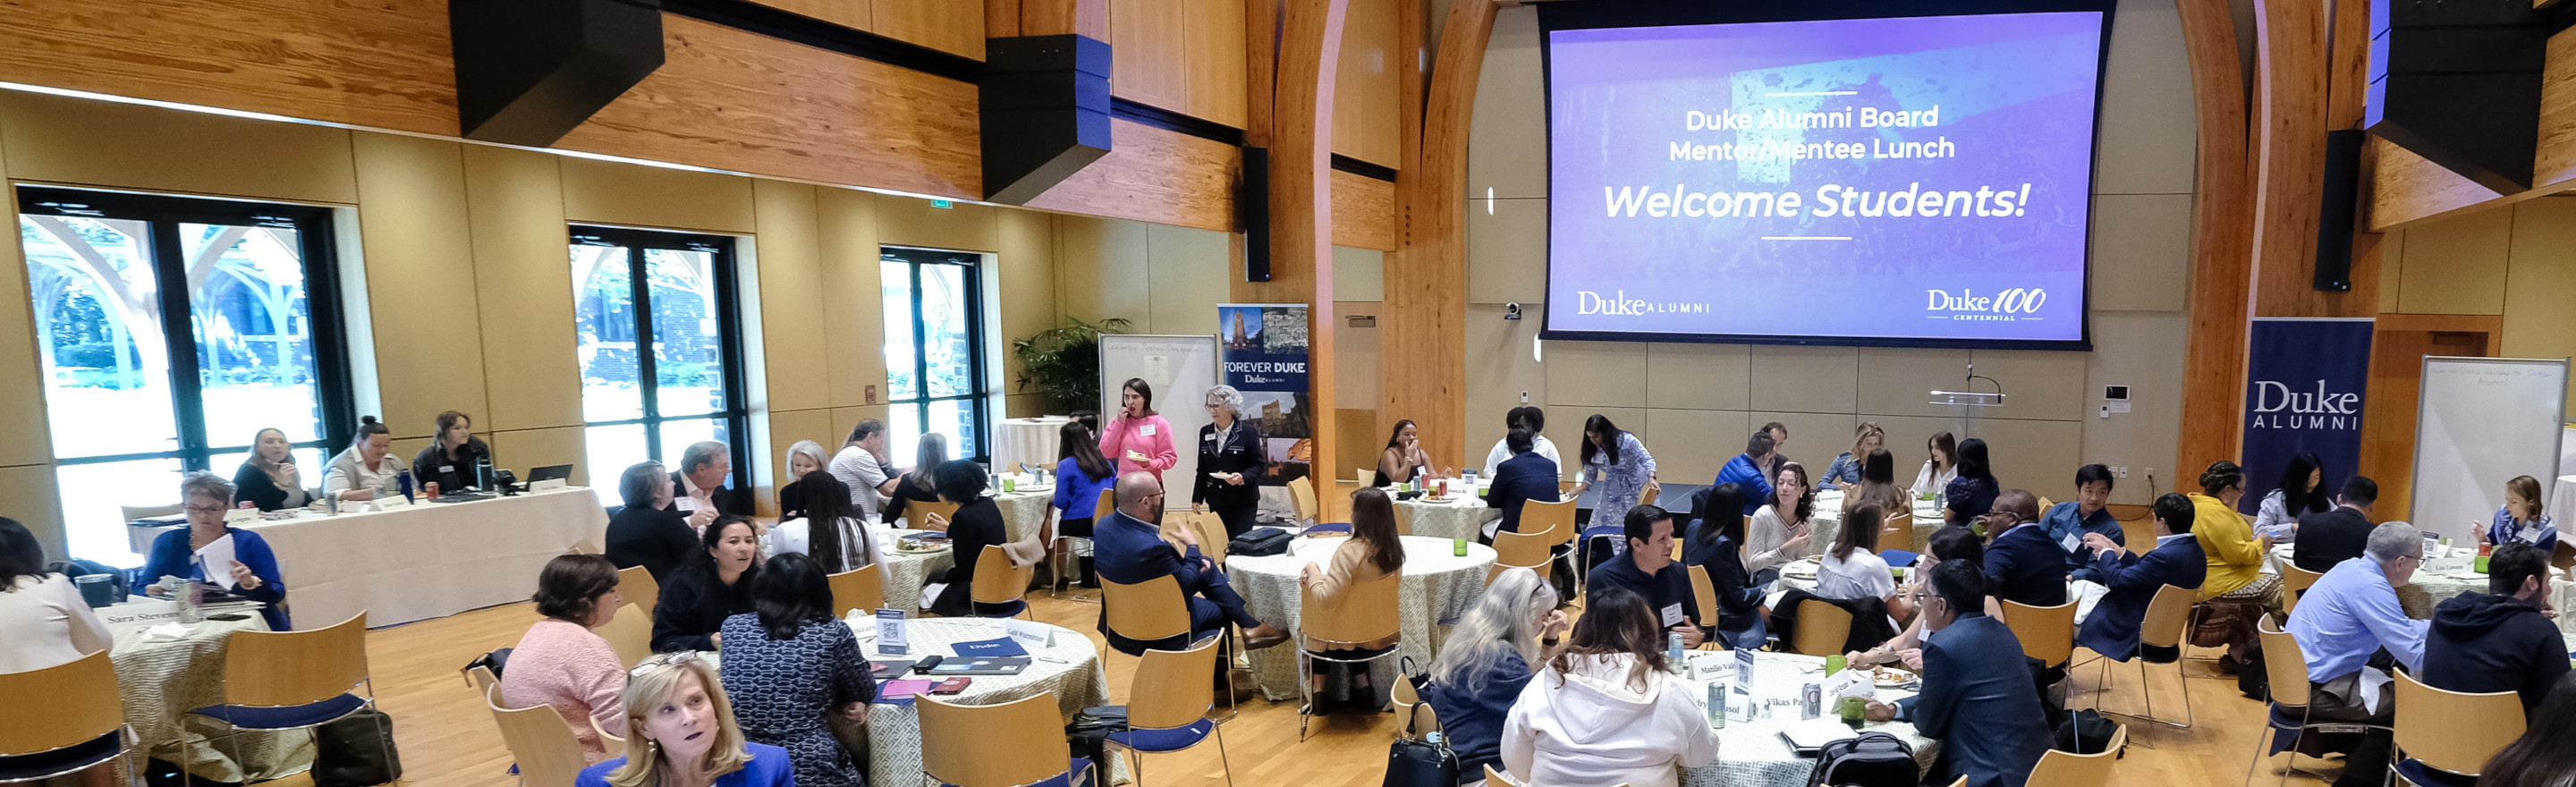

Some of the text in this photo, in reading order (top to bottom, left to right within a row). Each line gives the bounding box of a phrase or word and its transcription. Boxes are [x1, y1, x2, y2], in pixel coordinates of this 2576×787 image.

[1686, 105, 1939, 131] Duke Alumni Board
[1669, 136, 1956, 162] Mentor/Mentee Lunch
[1604, 182, 2032, 218] Welcome Students!
[1577, 289, 1710, 317] Duke ALUMNI
[1926, 287, 2047, 314] Duke 100
[1953, 314, 2016, 322] CENTENNIAL
[1224, 361, 1306, 373] FOREVER DUKE
[1244, 374, 1266, 384] Duke
[2254, 378, 2359, 415] Duke
[2253, 415, 2358, 431] ALUMNI
[107, 616, 134, 624] Sara
[1766, 698, 1791, 707] Vikas
